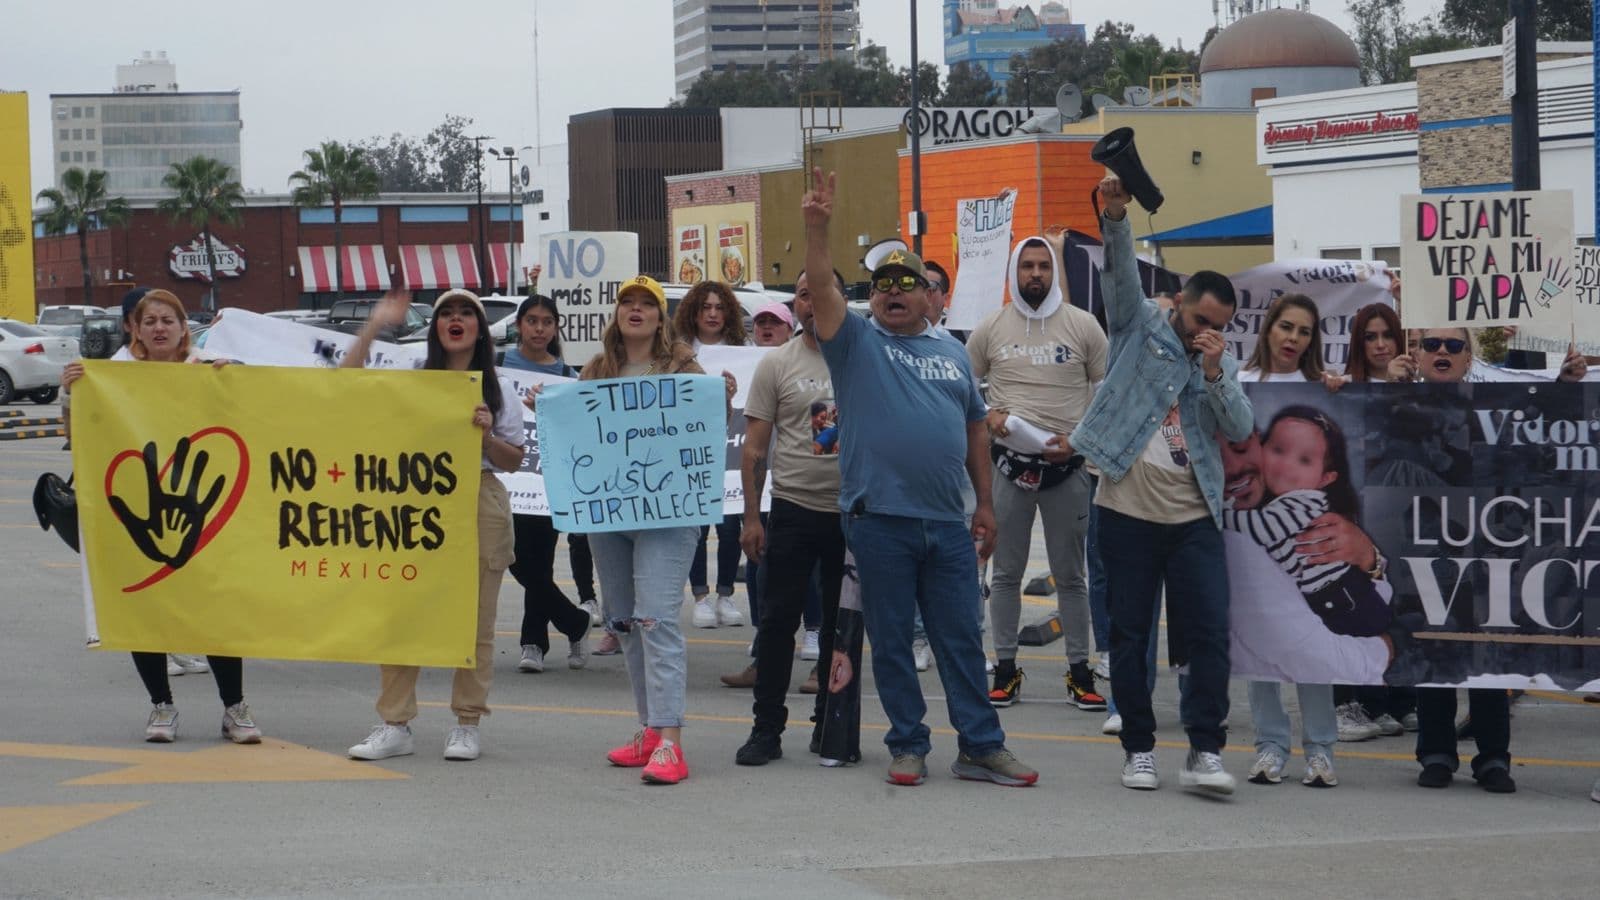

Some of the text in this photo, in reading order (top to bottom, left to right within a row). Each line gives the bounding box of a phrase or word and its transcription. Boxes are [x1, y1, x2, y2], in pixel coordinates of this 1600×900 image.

[1316, 119, 1370, 138] Happiness
[1416, 195, 1532, 241] DÉJAME
[181, 253, 234, 266] FRIDY'S
[548, 238, 605, 278] NO
[551, 283, 592, 306] más
[597, 378, 677, 411] TODO
[597, 411, 706, 456] lo puedo en
[270, 447, 317, 494] NO
[354, 451, 458, 496] HIJOS
[680, 446, 714, 470] QUE
[688, 471, 712, 491] ME
[279, 500, 446, 552] REHENES
[291, 558, 418, 581] MÉXICO
